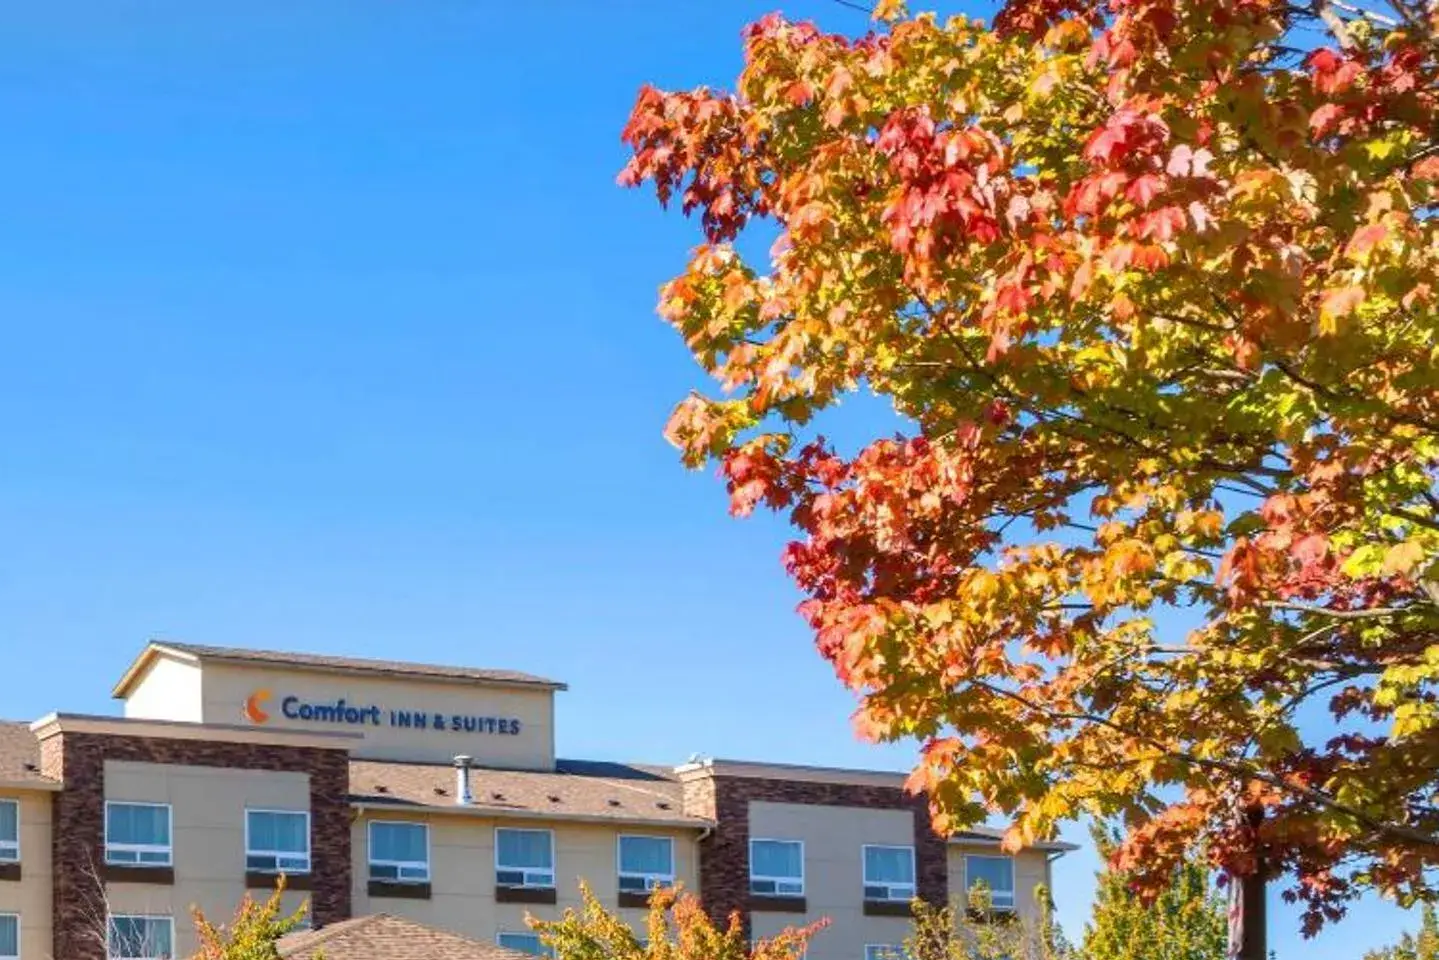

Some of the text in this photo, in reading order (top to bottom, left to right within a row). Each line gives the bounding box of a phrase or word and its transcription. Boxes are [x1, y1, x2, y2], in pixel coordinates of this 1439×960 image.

[282, 696, 521, 736] Comfort INN & SUITES
